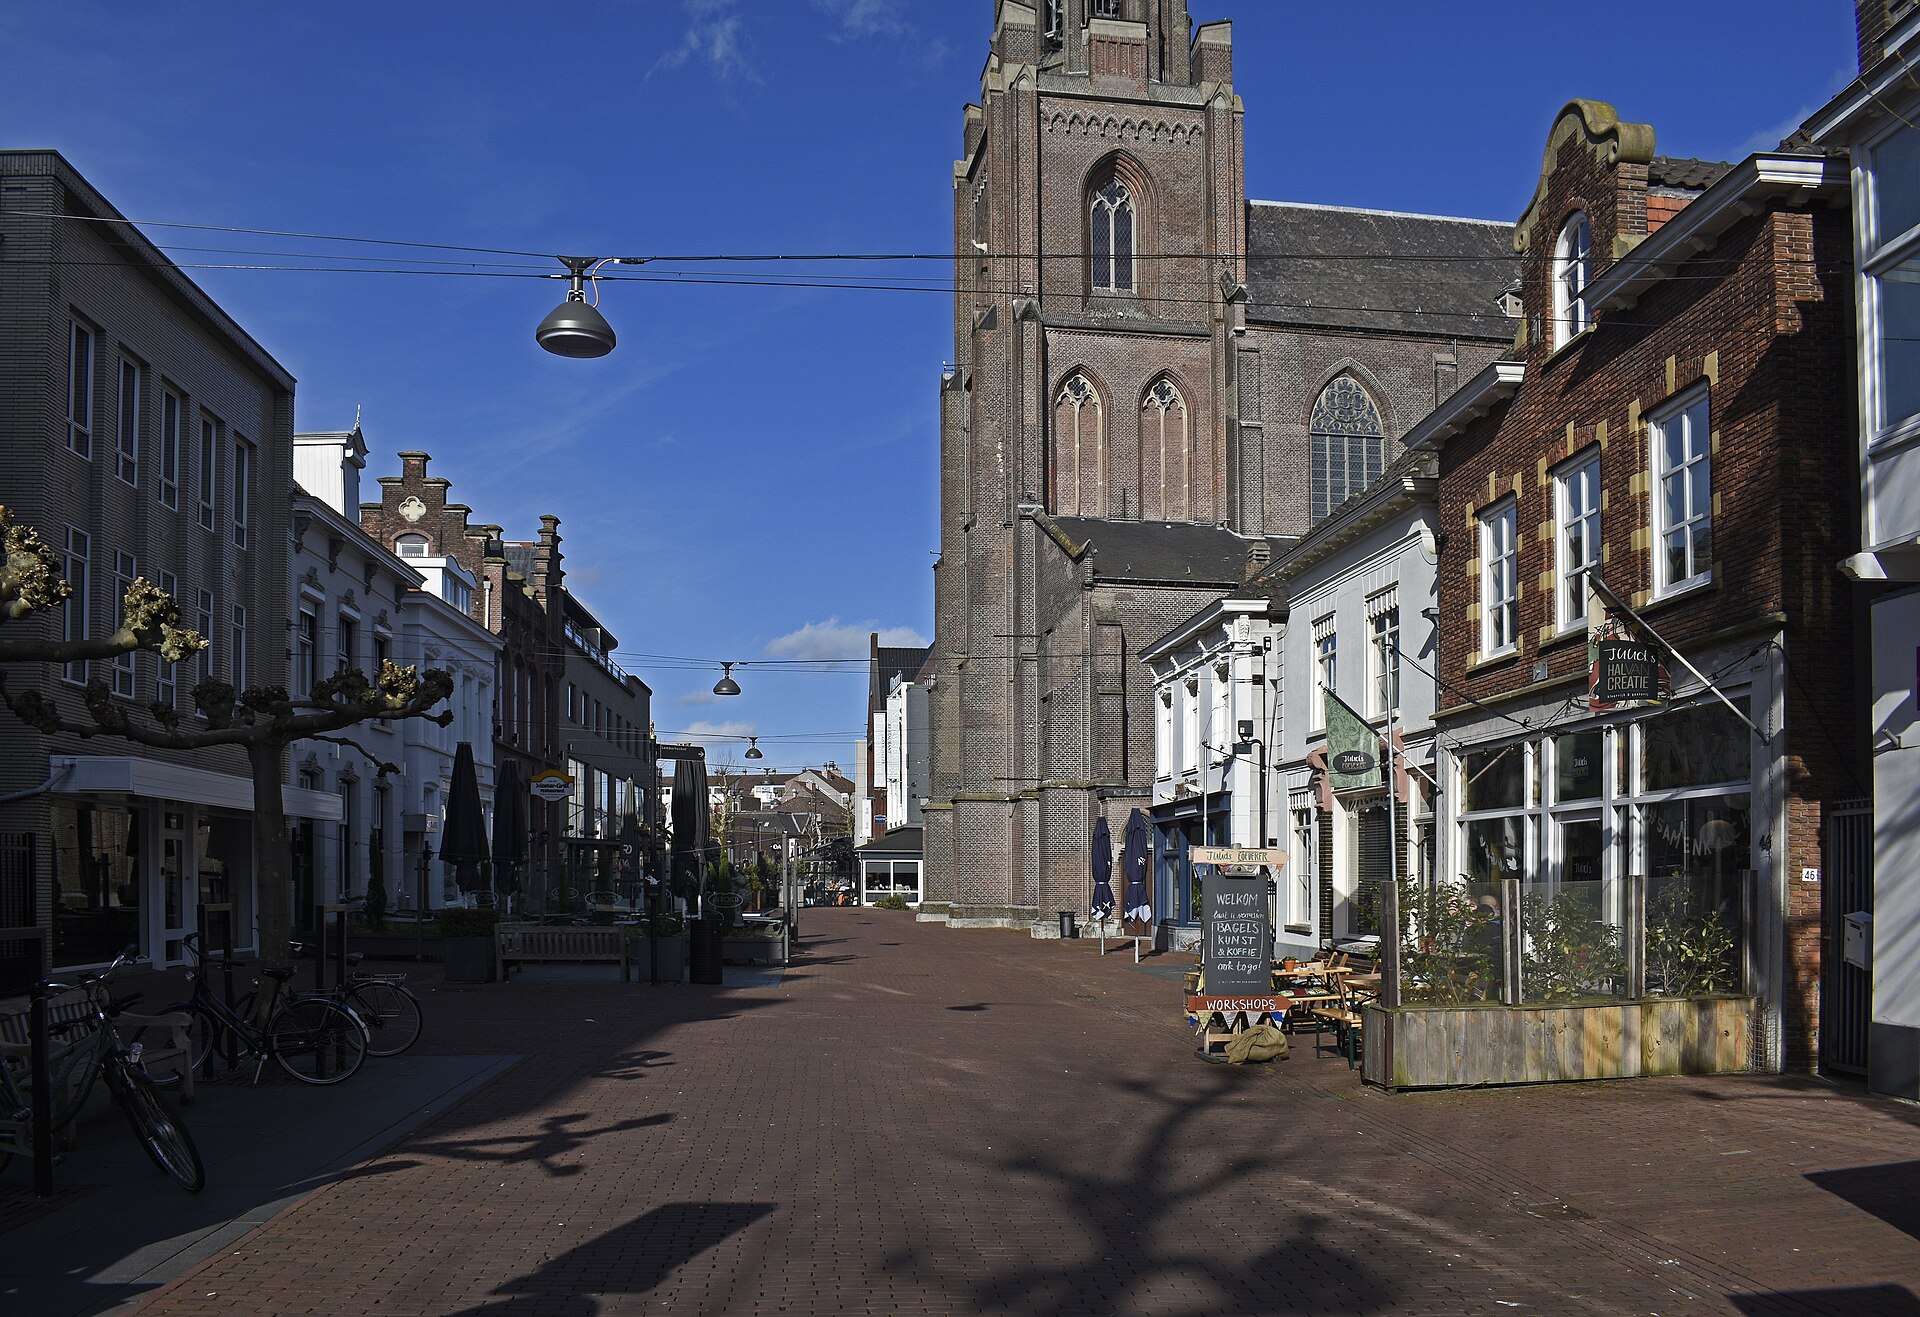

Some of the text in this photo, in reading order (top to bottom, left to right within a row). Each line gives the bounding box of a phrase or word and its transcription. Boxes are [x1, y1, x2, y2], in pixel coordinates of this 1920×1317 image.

[1607, 675, 1649, 691] CREATIE
[1804, 870, 1816, 880] 46
[1216, 893, 1258, 906] WELKOM
[1217, 923, 1260, 934] BAGELS
[1218, 935, 1257, 945] KUNST
[1218, 947, 1258, 957] & KOFFIE
[1217, 960, 1234, 971] ook
[1206, 998, 1276, 1011] WORKSHOPS
